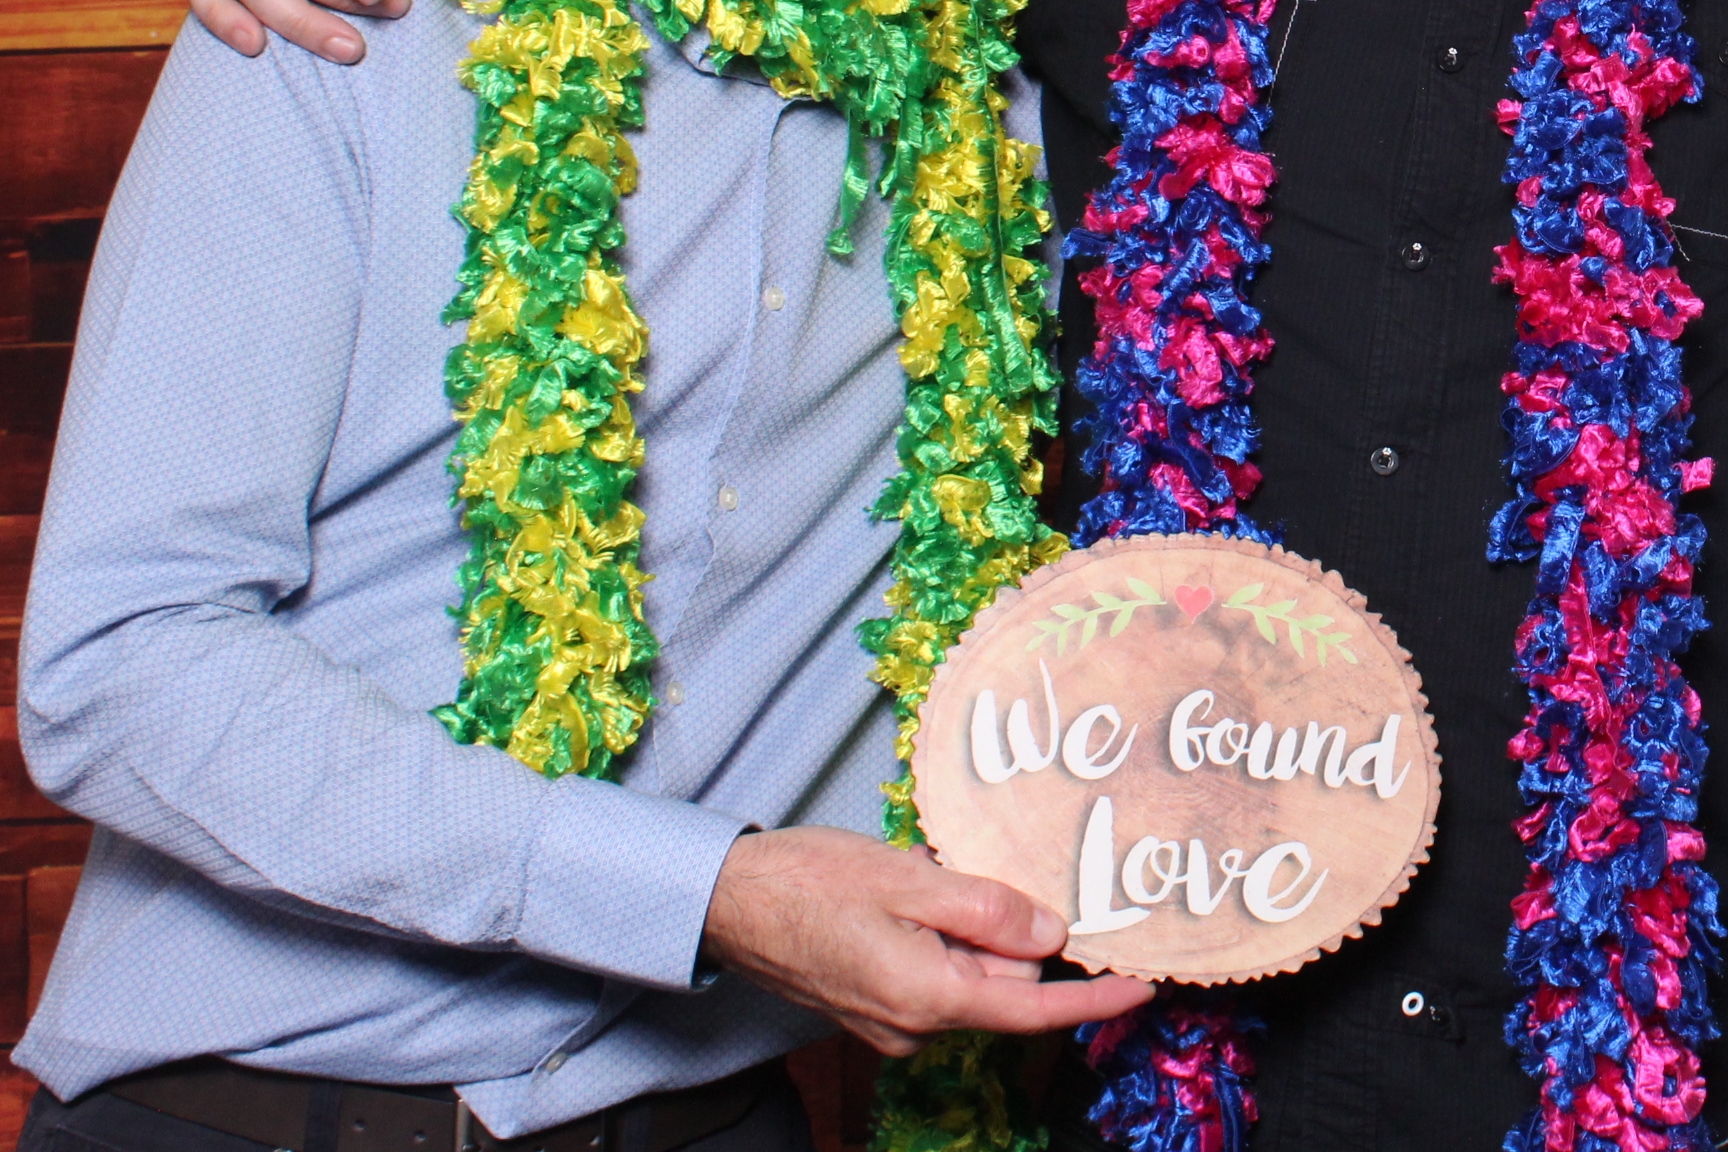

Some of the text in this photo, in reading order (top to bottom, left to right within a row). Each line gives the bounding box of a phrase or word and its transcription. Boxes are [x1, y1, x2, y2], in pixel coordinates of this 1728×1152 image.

[971, 658, 1413, 799] We found
[1067, 795, 1329, 935] Love
